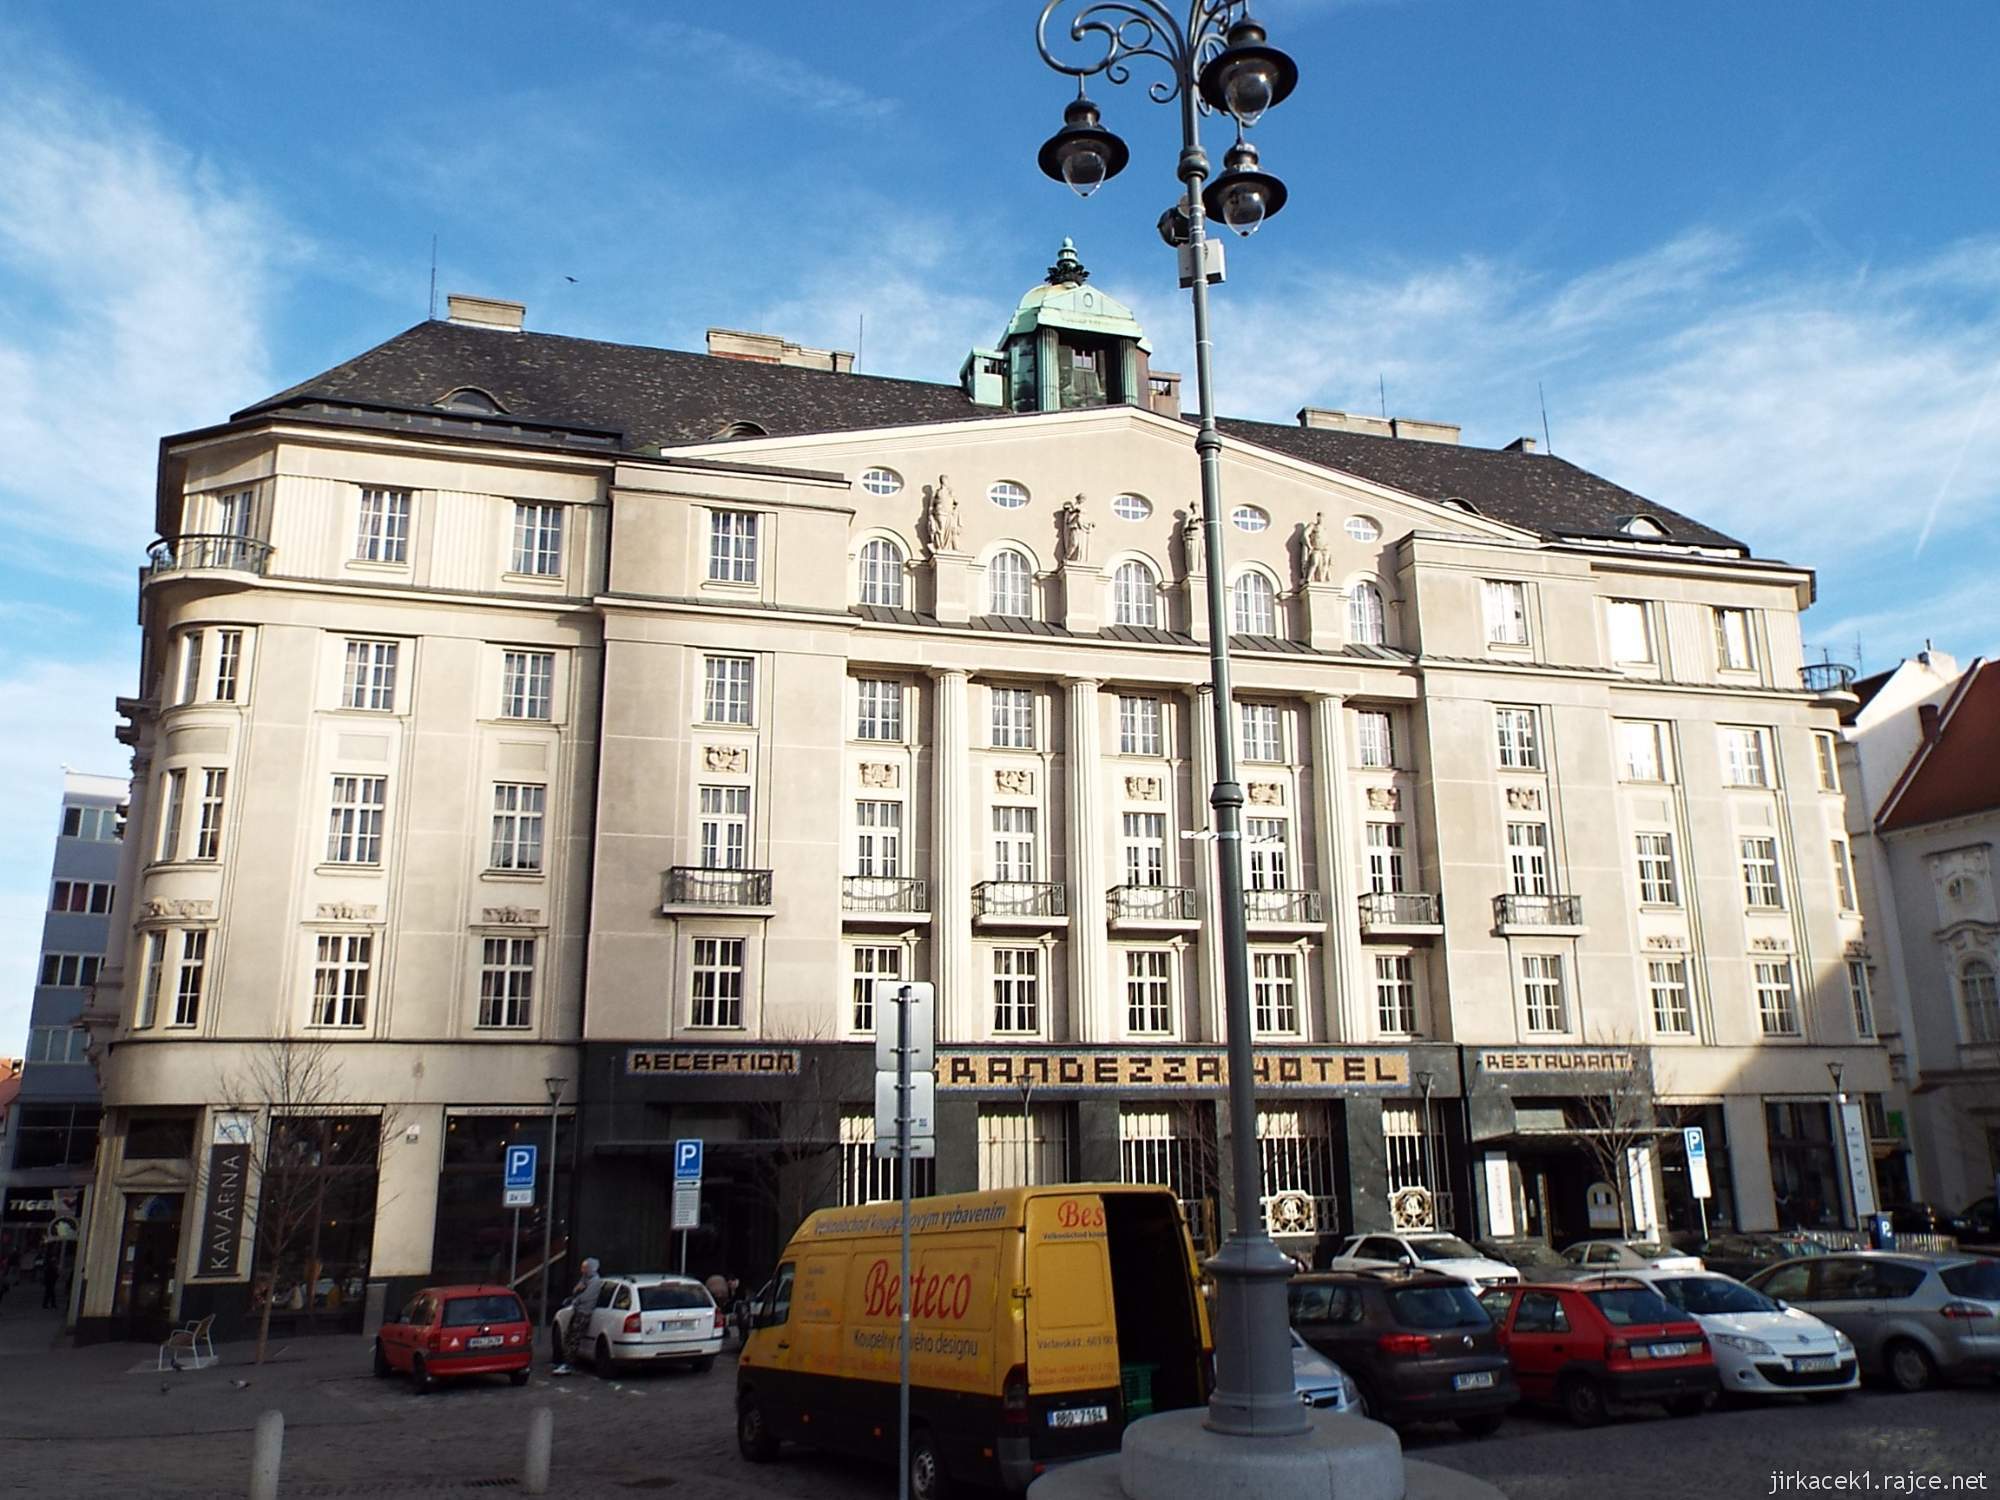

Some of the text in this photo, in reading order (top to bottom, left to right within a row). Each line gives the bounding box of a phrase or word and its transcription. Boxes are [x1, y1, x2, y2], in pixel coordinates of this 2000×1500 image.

[633, 1053, 795, 1071] RECEPTION
[935, 1057, 1397, 1083] RANDEZZA HOTEL
[1485, 1054, 1630, 1070] RESTAURANT
[1689, 1131, 1700, 1150] P
[512, 1151, 530, 1175] P
[680, 1144, 697, 1167] P
[210, 1154, 241, 1270] KAVÁRNA
[942, 1200, 1007, 1230] vybavením
[1058, 1200, 1104, 1228] Bes
[864, 1259, 972, 1320] Beteco
[936, 1332, 977, 1361] designu
